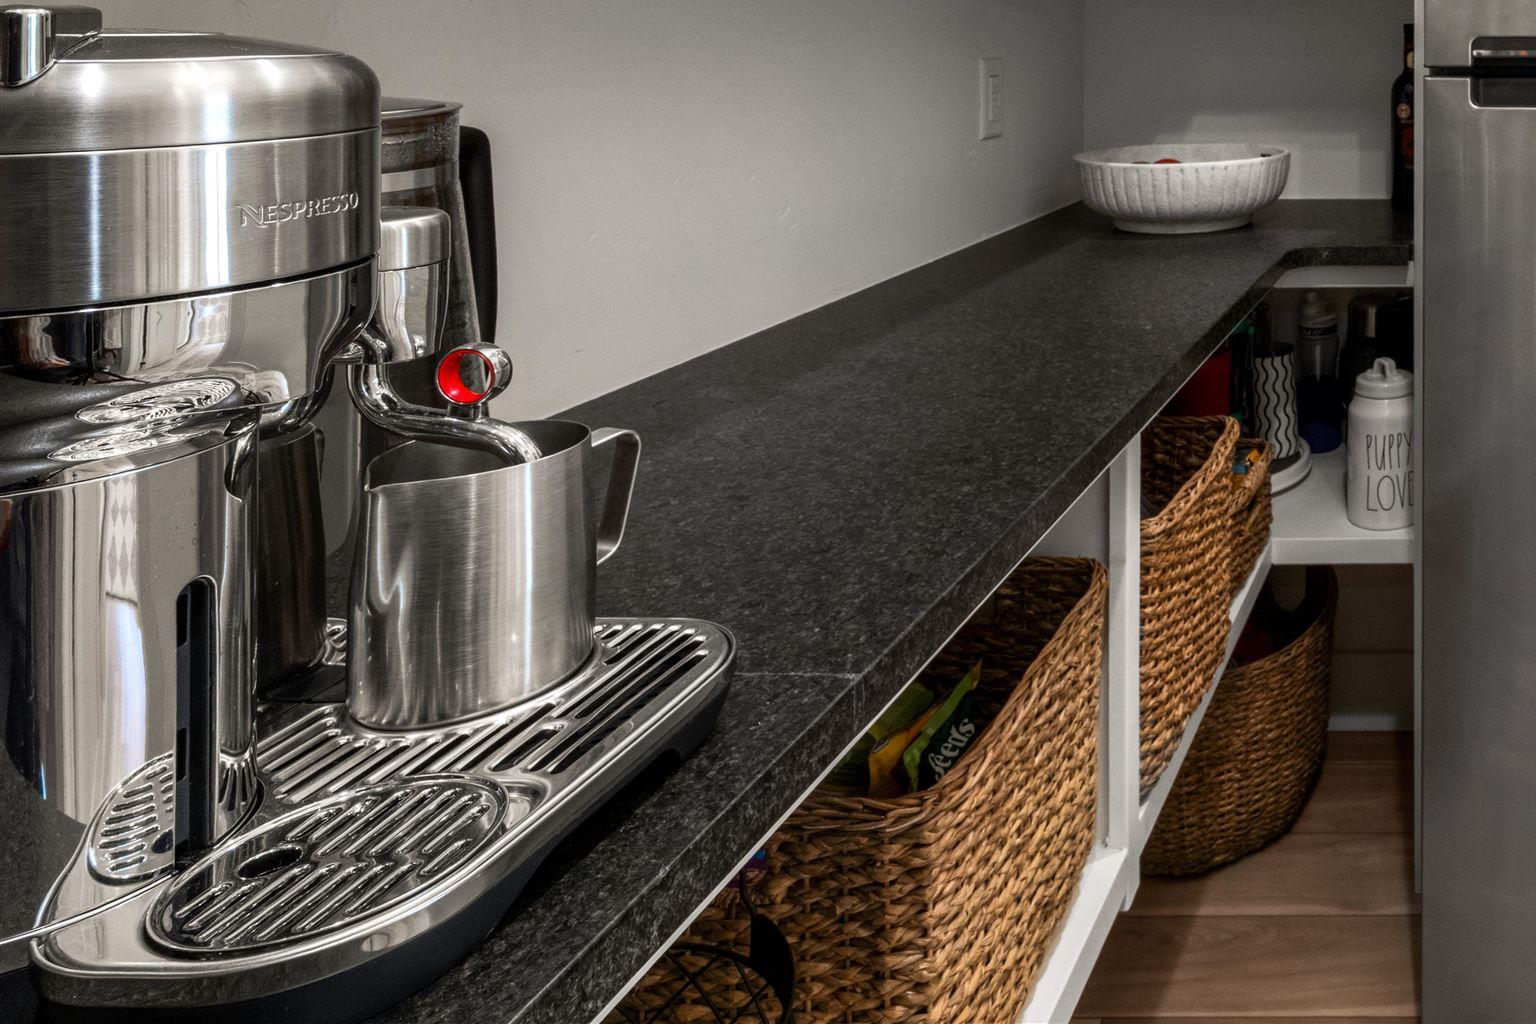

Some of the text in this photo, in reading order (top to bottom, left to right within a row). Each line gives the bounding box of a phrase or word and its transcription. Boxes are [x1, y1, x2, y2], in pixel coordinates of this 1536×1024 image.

[236, 191, 359, 228] NESPRESSO
[1366, 431, 1413, 471] PUPPY
[1366, 470, 1414, 512] LOVE
